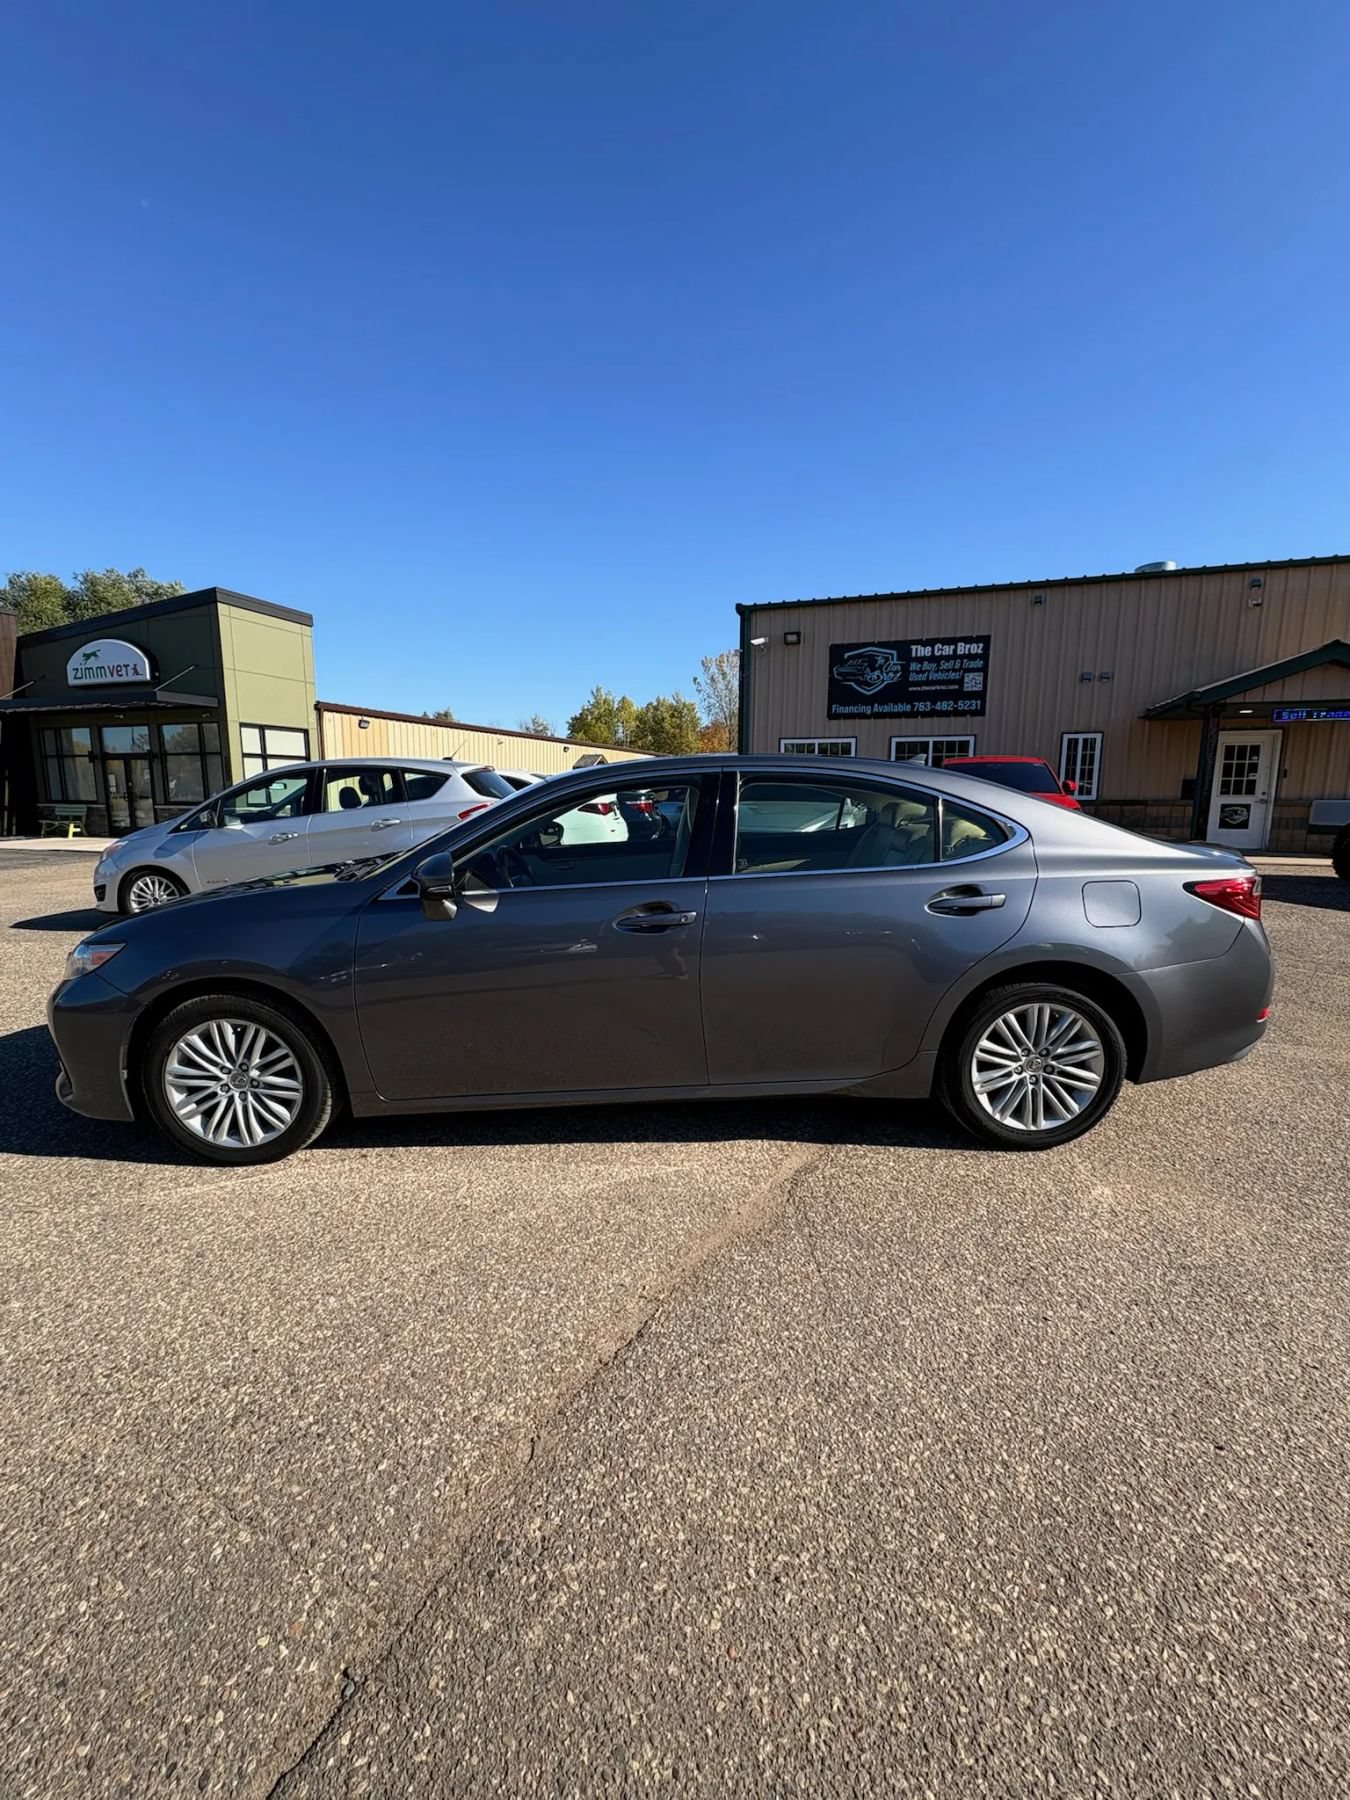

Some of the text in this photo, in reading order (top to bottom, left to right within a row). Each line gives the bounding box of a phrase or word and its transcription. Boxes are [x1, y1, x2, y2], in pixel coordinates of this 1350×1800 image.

[910, 642, 984, 657] The Car Broz
[910, 658, 984, 673] We Buy, Sell & Trade
[909, 670, 963, 682] Used Vehicles!
[831, 700, 981, 715] Financing Available 763-482-5231
